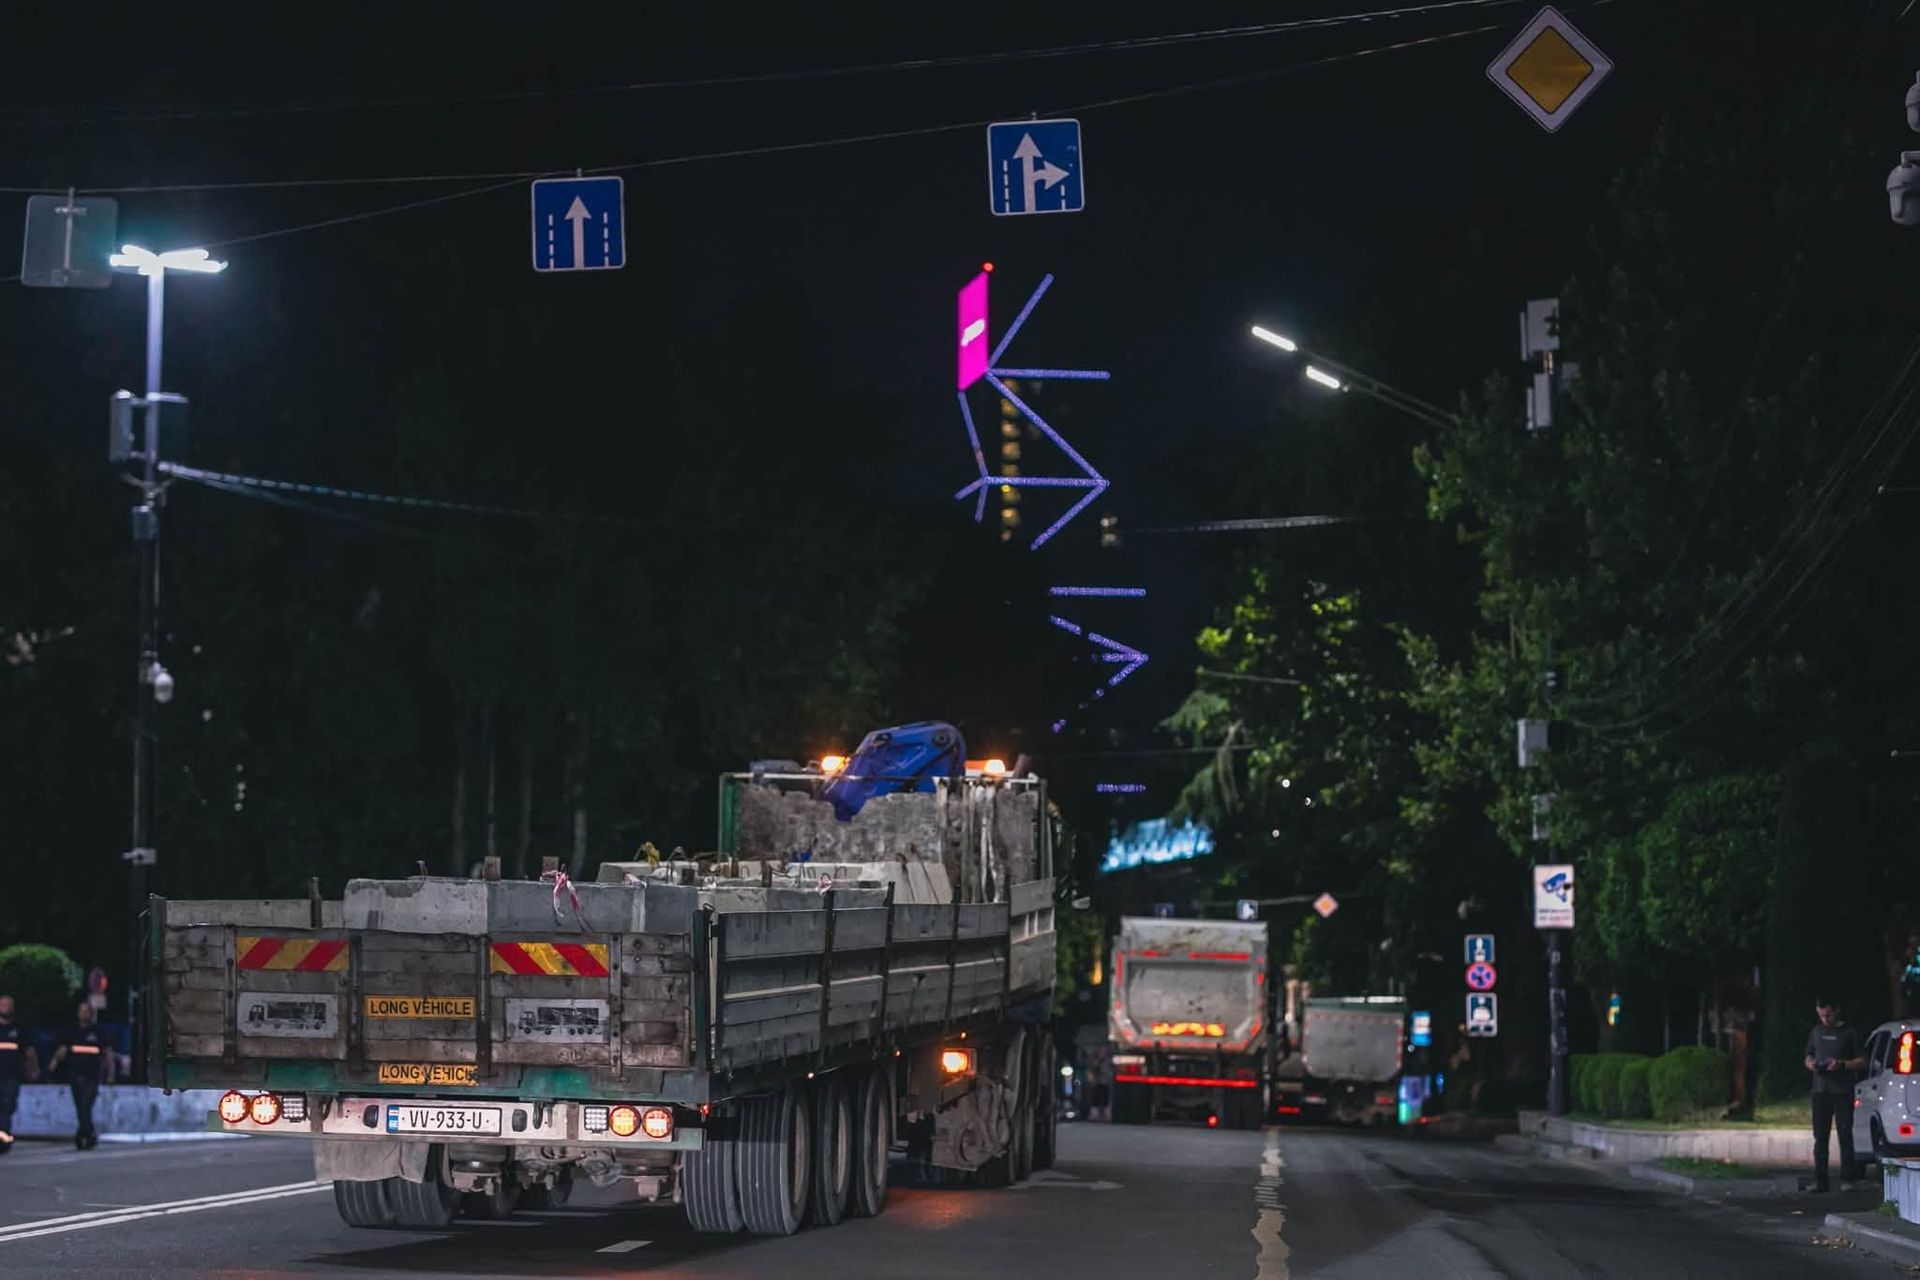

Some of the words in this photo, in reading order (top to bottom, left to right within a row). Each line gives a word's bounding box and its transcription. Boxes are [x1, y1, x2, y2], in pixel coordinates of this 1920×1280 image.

[370, 1000, 409, 1014] LONG
[413, 1000, 471, 1015] VEHICLE
[381, 1065, 420, 1079] LONG
[423, 1065, 476, 1081] VEHICL
[409, 1110, 482, 1129] VV-933-U
